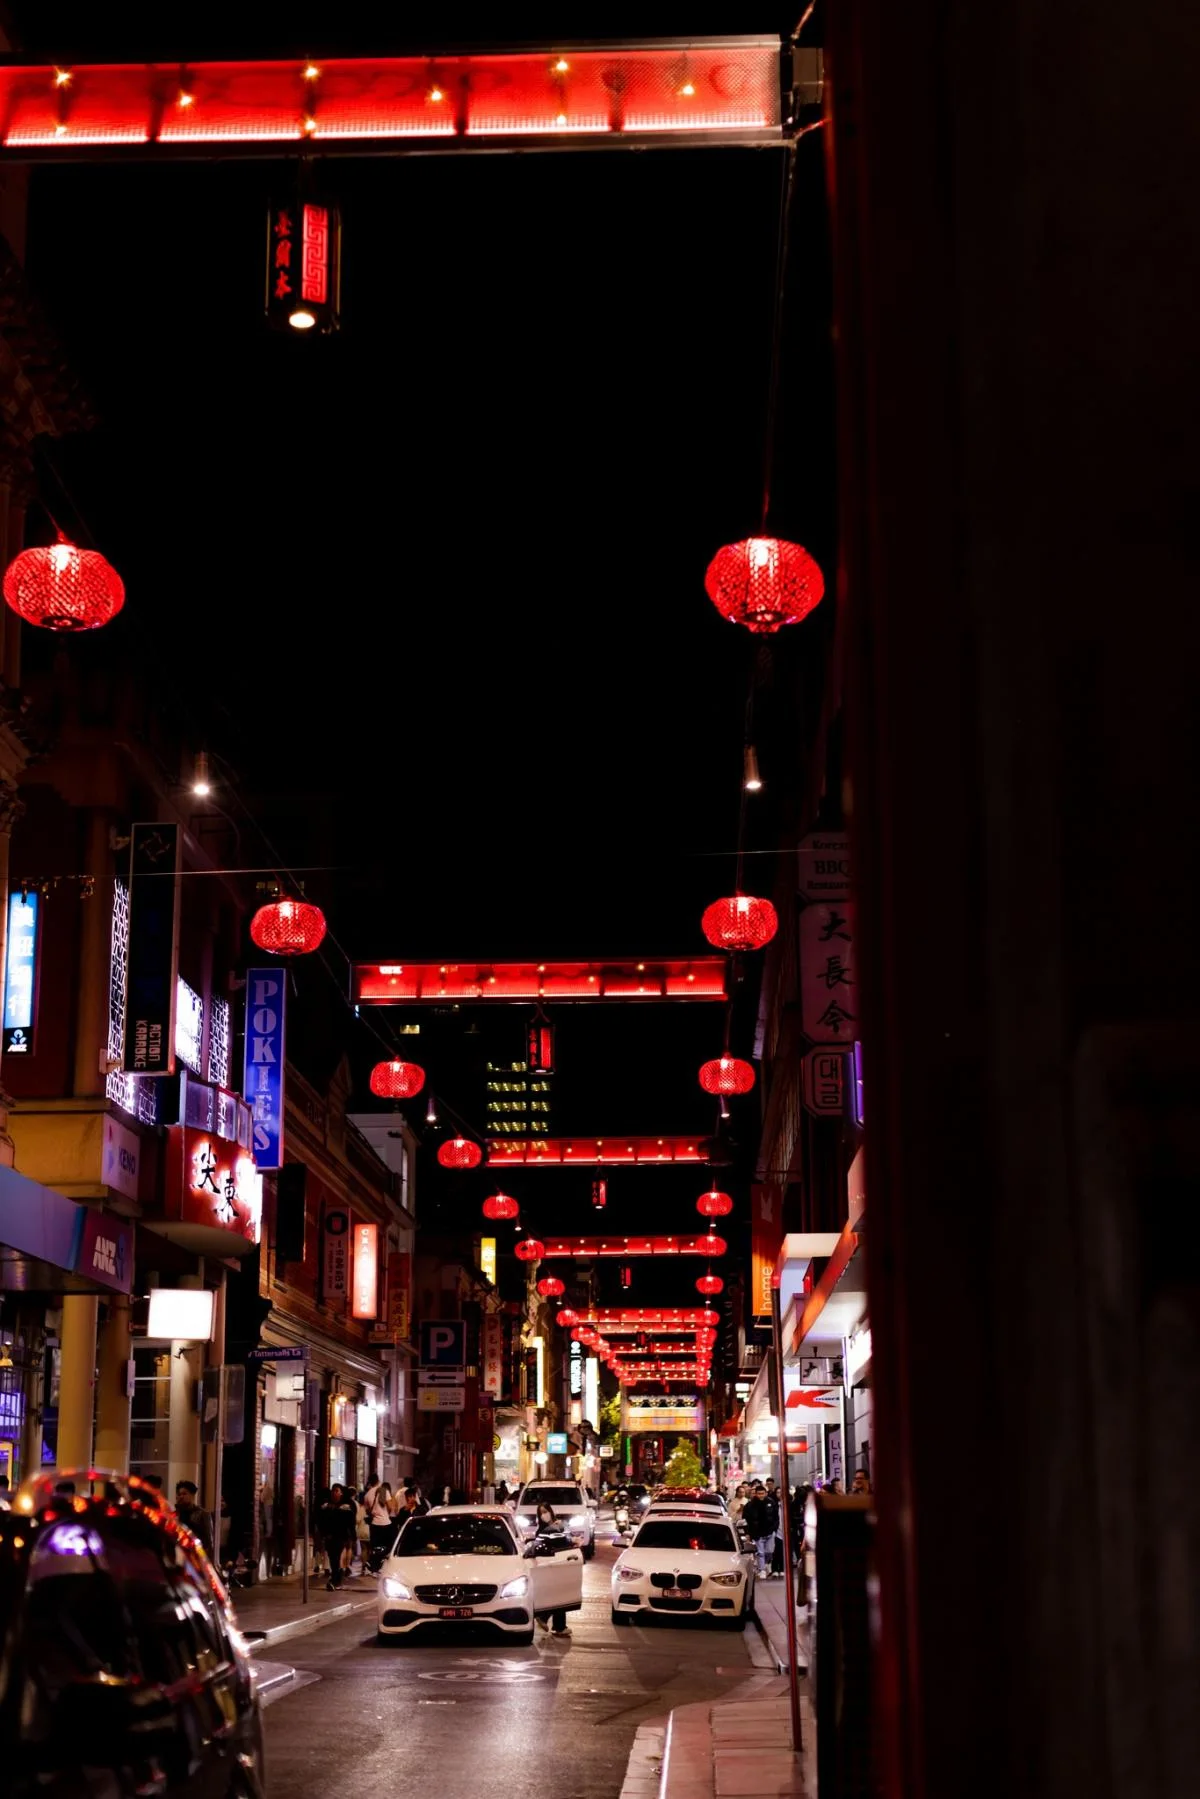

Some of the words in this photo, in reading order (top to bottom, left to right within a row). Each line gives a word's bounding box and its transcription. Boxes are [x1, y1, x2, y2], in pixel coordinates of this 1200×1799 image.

[816, 911, 858, 1034] 大長今
[134, 1020, 148, 1069] KARAOKE
[252, 979, 278, 1151] POKIES
[92, 1235, 117, 1276] ANZ
[760, 1265, 774, 1312] home
[254, 1349, 290, 1358] Tattersalls
[429, 1326, 456, 1361] P
